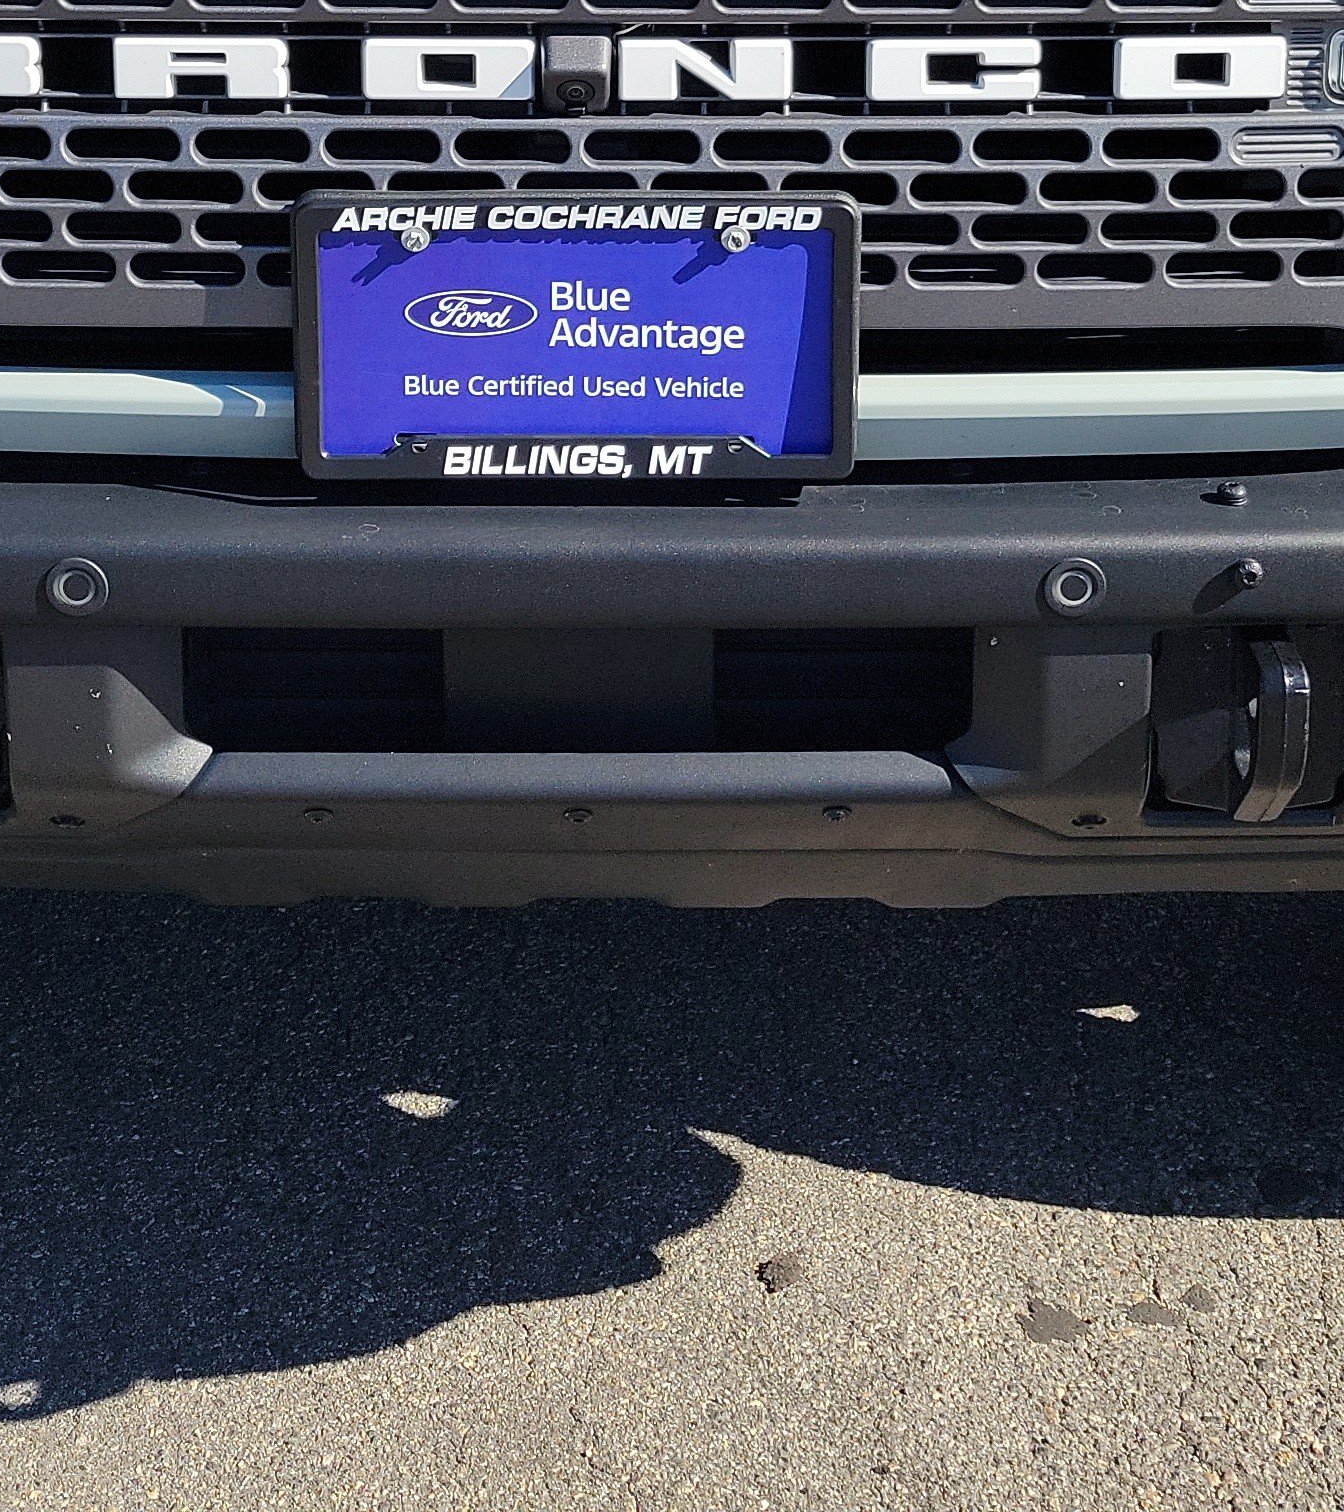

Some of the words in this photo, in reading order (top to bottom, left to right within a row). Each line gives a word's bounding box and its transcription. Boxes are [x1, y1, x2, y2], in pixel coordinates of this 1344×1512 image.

[332, 204, 478, 232] ARCHIE
[487, 204, 707, 231] COCHRANE
[713, 205, 823, 232] FORD
[430, 295, 514, 330] Ford
[550, 280, 631, 312] Blue
[548, 316, 746, 356] Advantage
[403, 374, 460, 397] Blue
[467, 373, 575, 398] Certified
[582, 375, 647, 398] Used
[654, 376, 745, 399] Vehicle
[443, 443, 634, 479] BILLINGS,
[648, 444, 714, 476] MT
